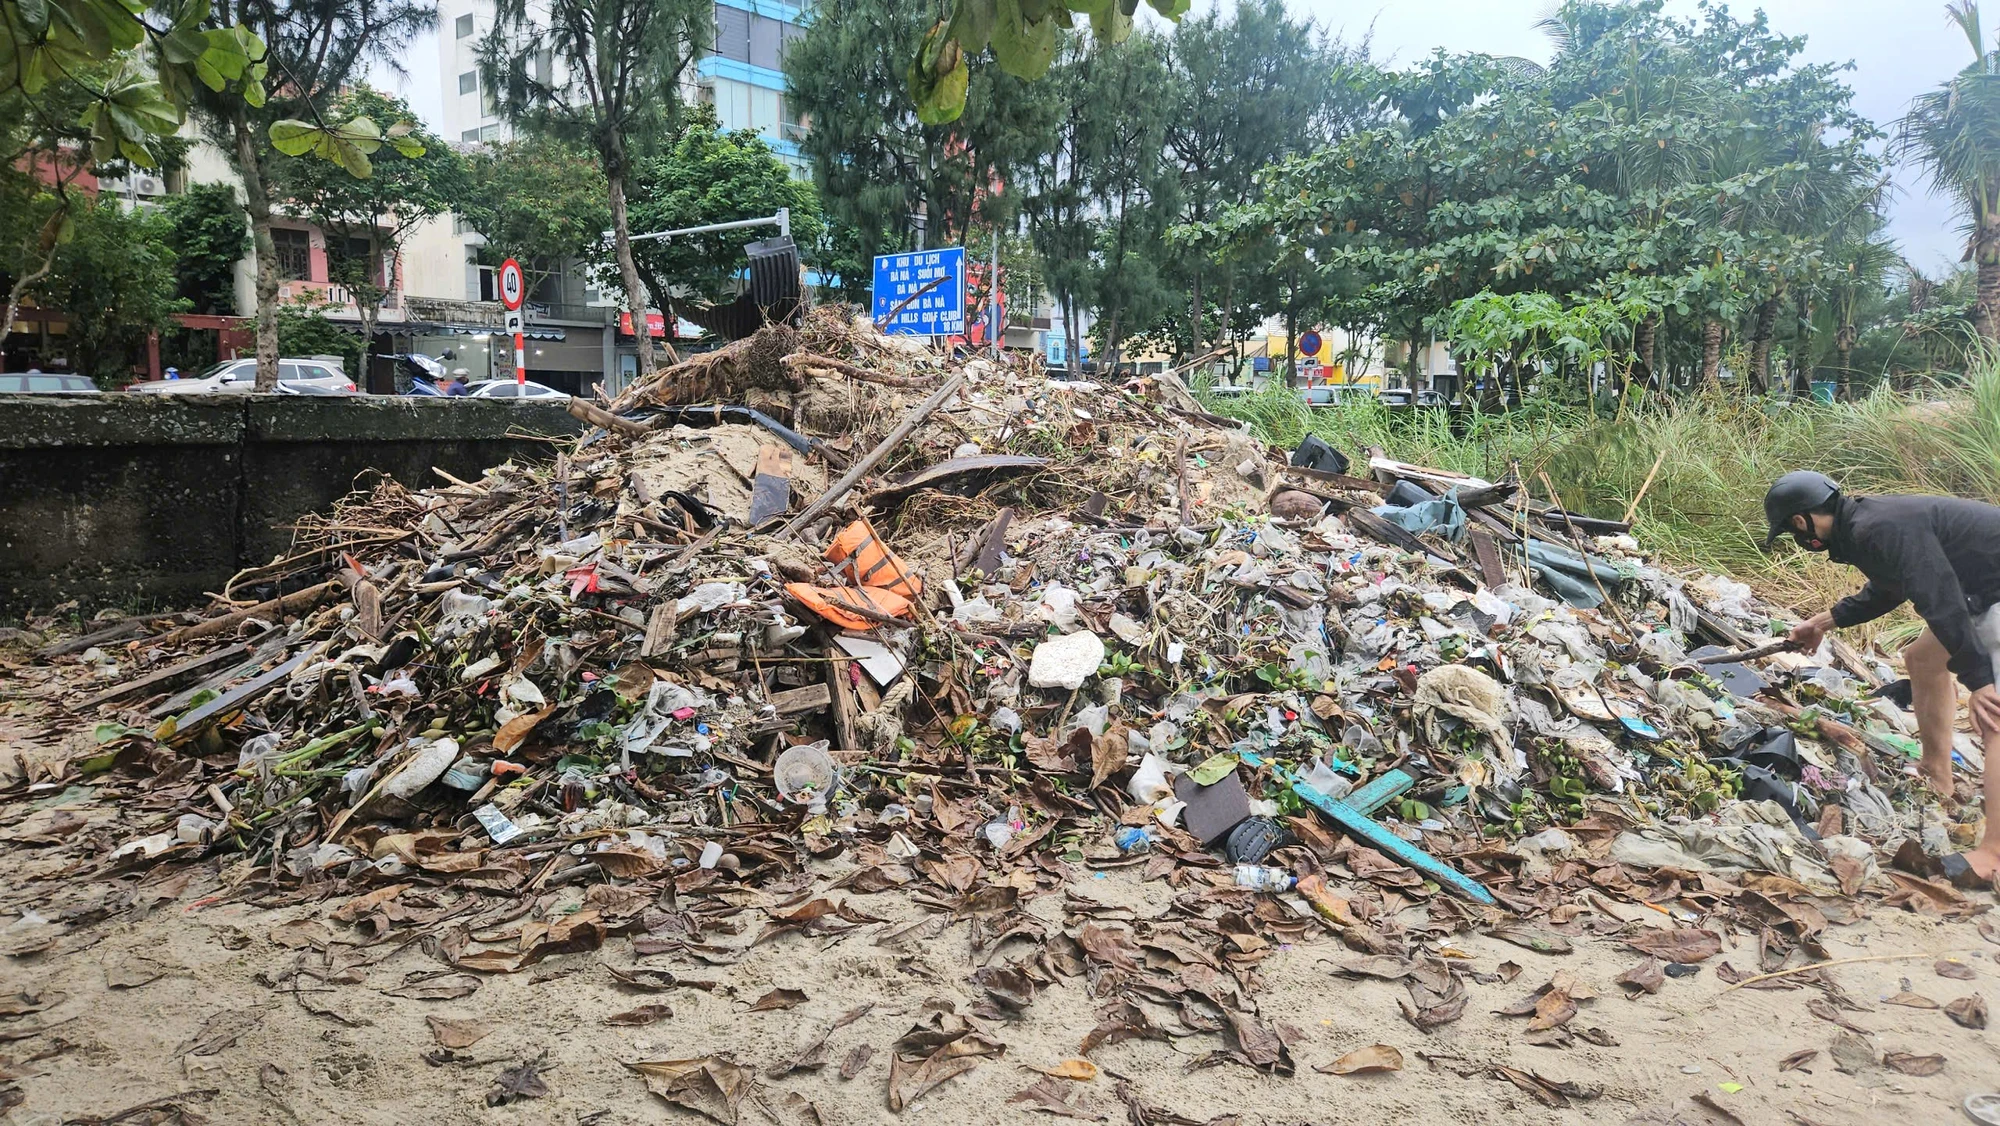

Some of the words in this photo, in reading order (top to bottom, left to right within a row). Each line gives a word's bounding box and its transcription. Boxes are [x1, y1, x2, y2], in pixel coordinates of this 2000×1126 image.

[896, 256, 909, 268] KHU
[914, 254, 923, 266] DU
[890, 269, 898, 282] BÀ
[900, 268, 910, 281] NÀ
[507, 272, 517, 293] 40
[896, 282, 906, 294] BÀ
[908, 281, 918, 294] NÀ
[922, 295, 932, 309] BÀ
[935, 295, 944, 308] NÀ
[901, 312, 919, 324] HILLS
[922, 311, 939, 323] GOLF
[940, 310, 957, 322] CLUB
[951, 320, 963, 332] KM
